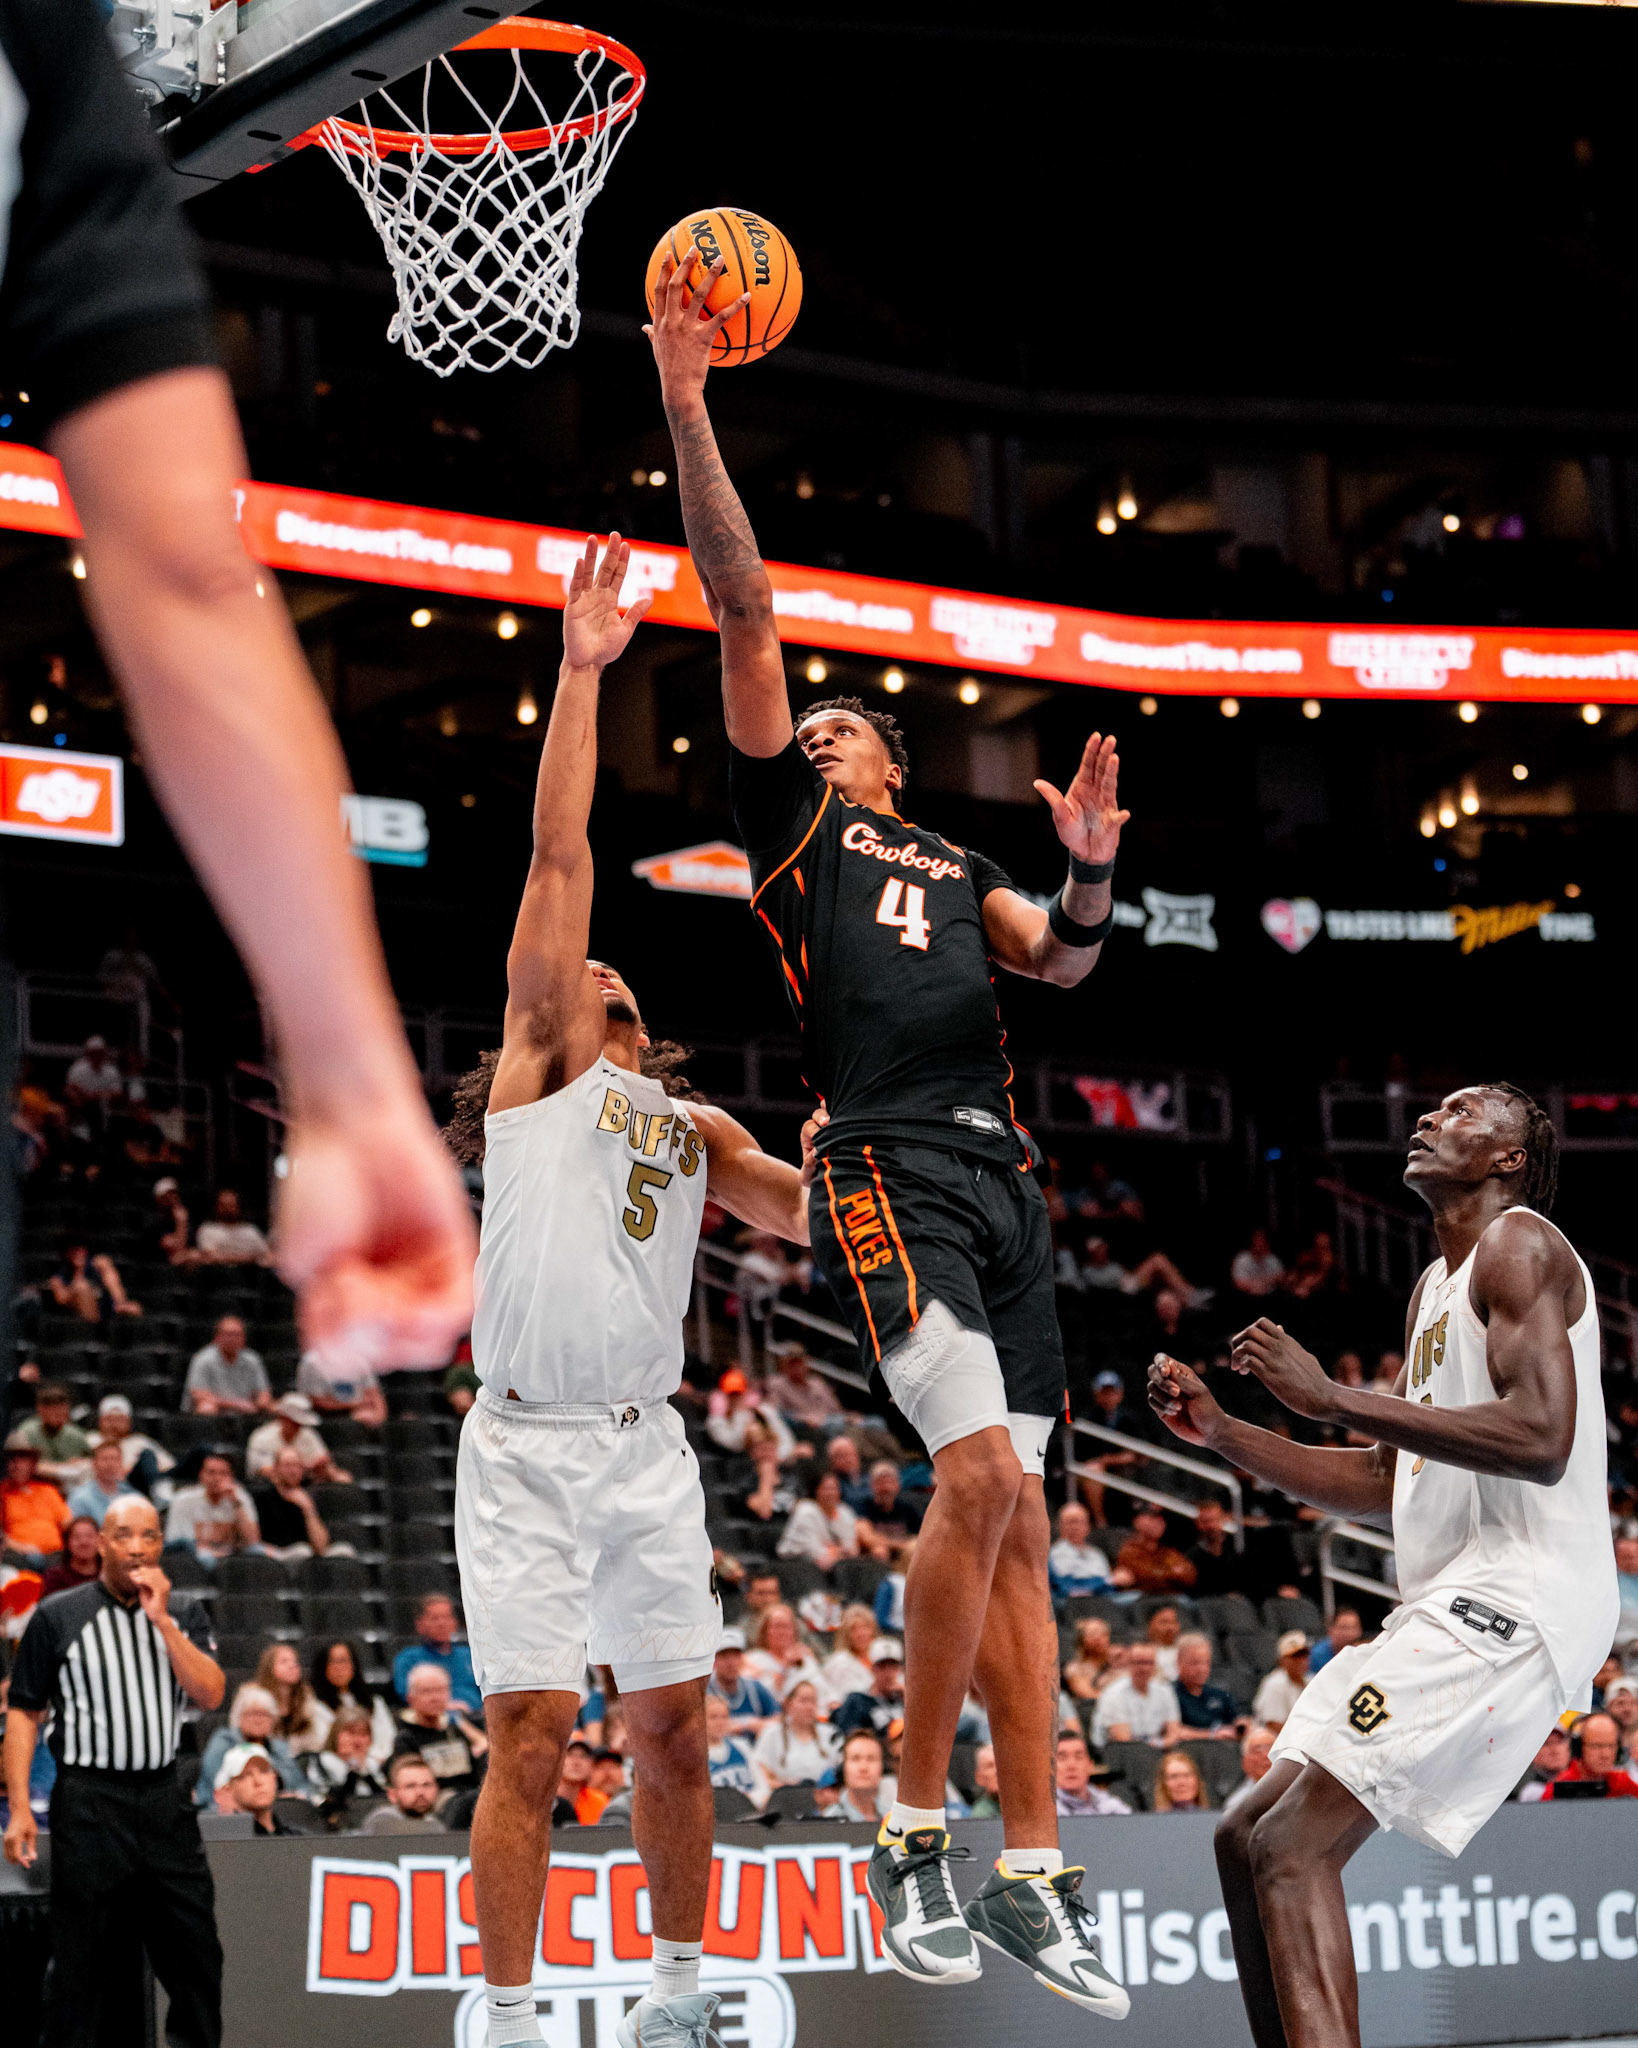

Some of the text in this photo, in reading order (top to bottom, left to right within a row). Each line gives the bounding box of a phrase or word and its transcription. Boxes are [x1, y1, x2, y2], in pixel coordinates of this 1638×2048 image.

[842, 822, 966, 880] Cowboys
[876, 876, 932, 952] 4
[596, 1088, 707, 1177] BUFFS
[622, 1161, 674, 1242] 5
[838, 1187, 893, 1274] POKES
[1494, 1619, 1508, 1631] 48
[1072, 1873, 1638, 1986] discnttire.c
